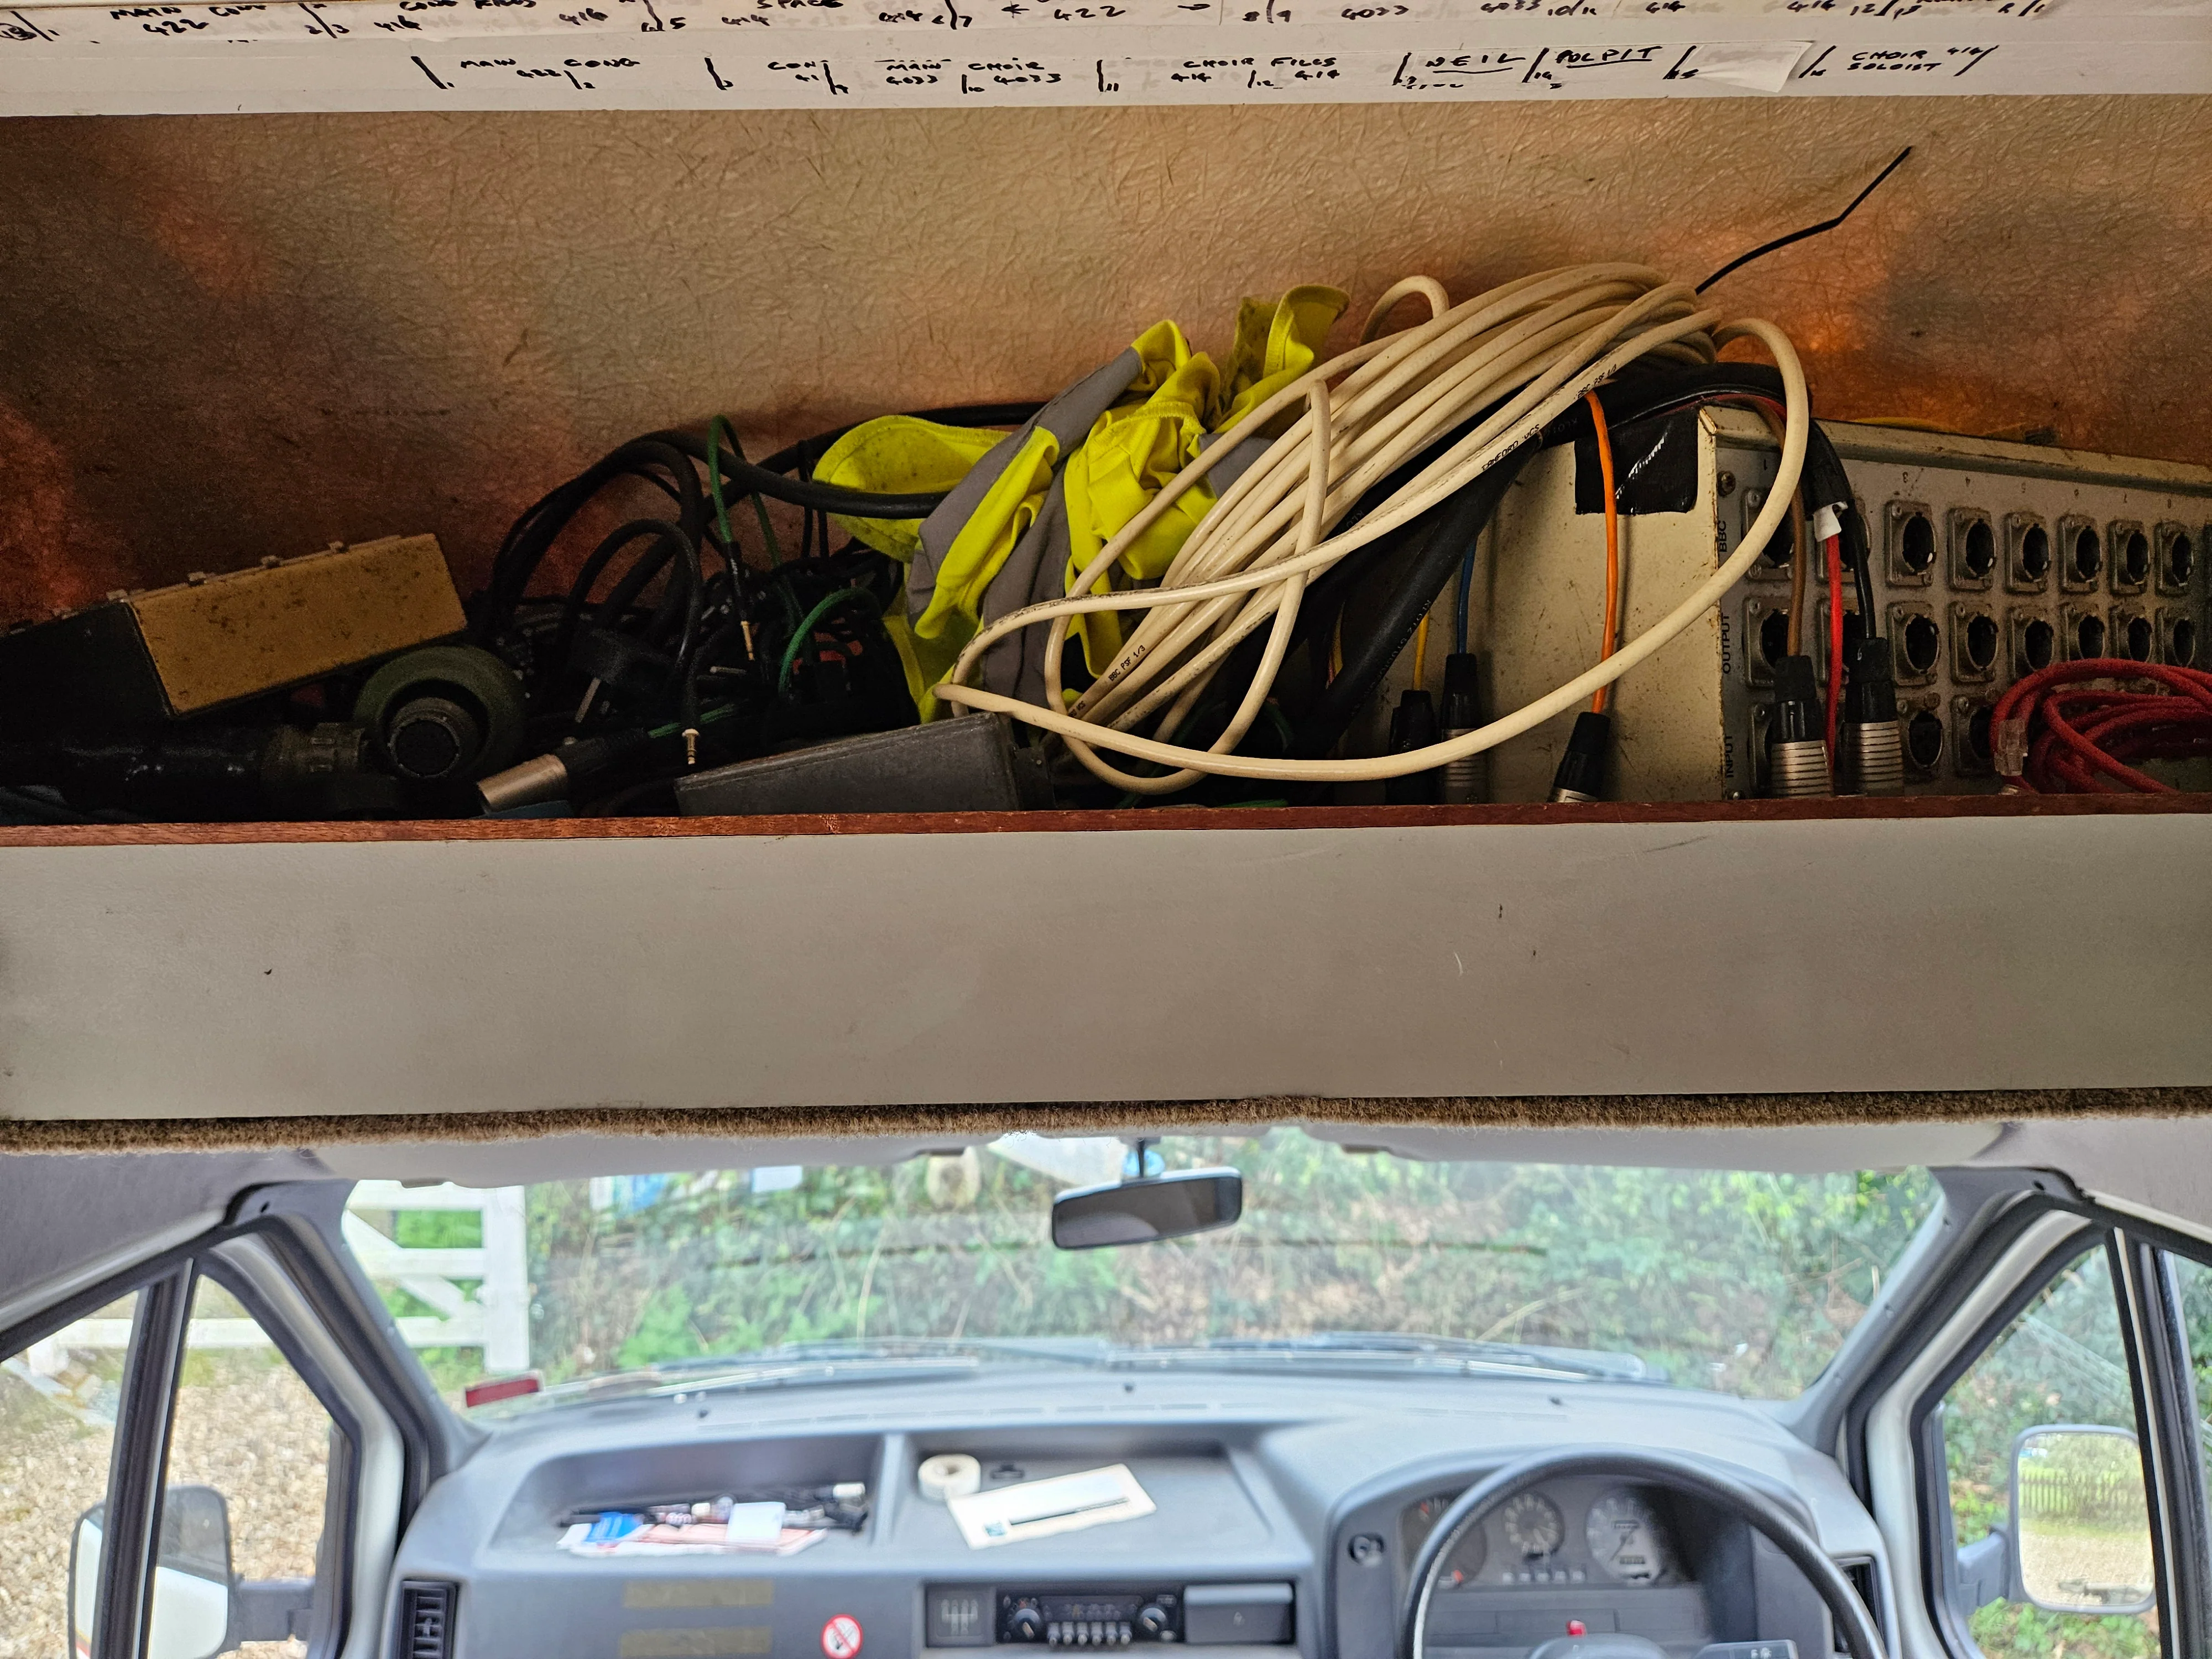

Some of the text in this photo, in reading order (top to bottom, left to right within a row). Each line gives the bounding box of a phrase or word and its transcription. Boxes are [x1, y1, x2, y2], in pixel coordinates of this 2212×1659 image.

[110, 7, 181, 19] MAIN
[143, 19, 209, 35] 422
[1055, 6, 1125, 20] 422
[1425, 53, 1526, 67] NEIL
[1853, 50, 1927, 61] CHOIR
[461, 59, 516, 69] MAIN
[564, 58, 640, 67] CONG
[768, 61, 816, 70] CON
[968, 62, 1044, 70] CHOIR
[1183, 58, 1254, 68] CHOIR
[1848, 62, 1942, 71] SOLOIST
[994, 74, 1061, 85] 4033
[1718, 520, 1727, 552] BBC
[1720, 612, 1731, 674] OUTPUT
[1108, 668, 1121, 682] BBC
[1120, 656, 1133, 670] PSF
[1133, 645, 1146, 658] 1/3
[1724, 733, 1734, 778] INPUT
